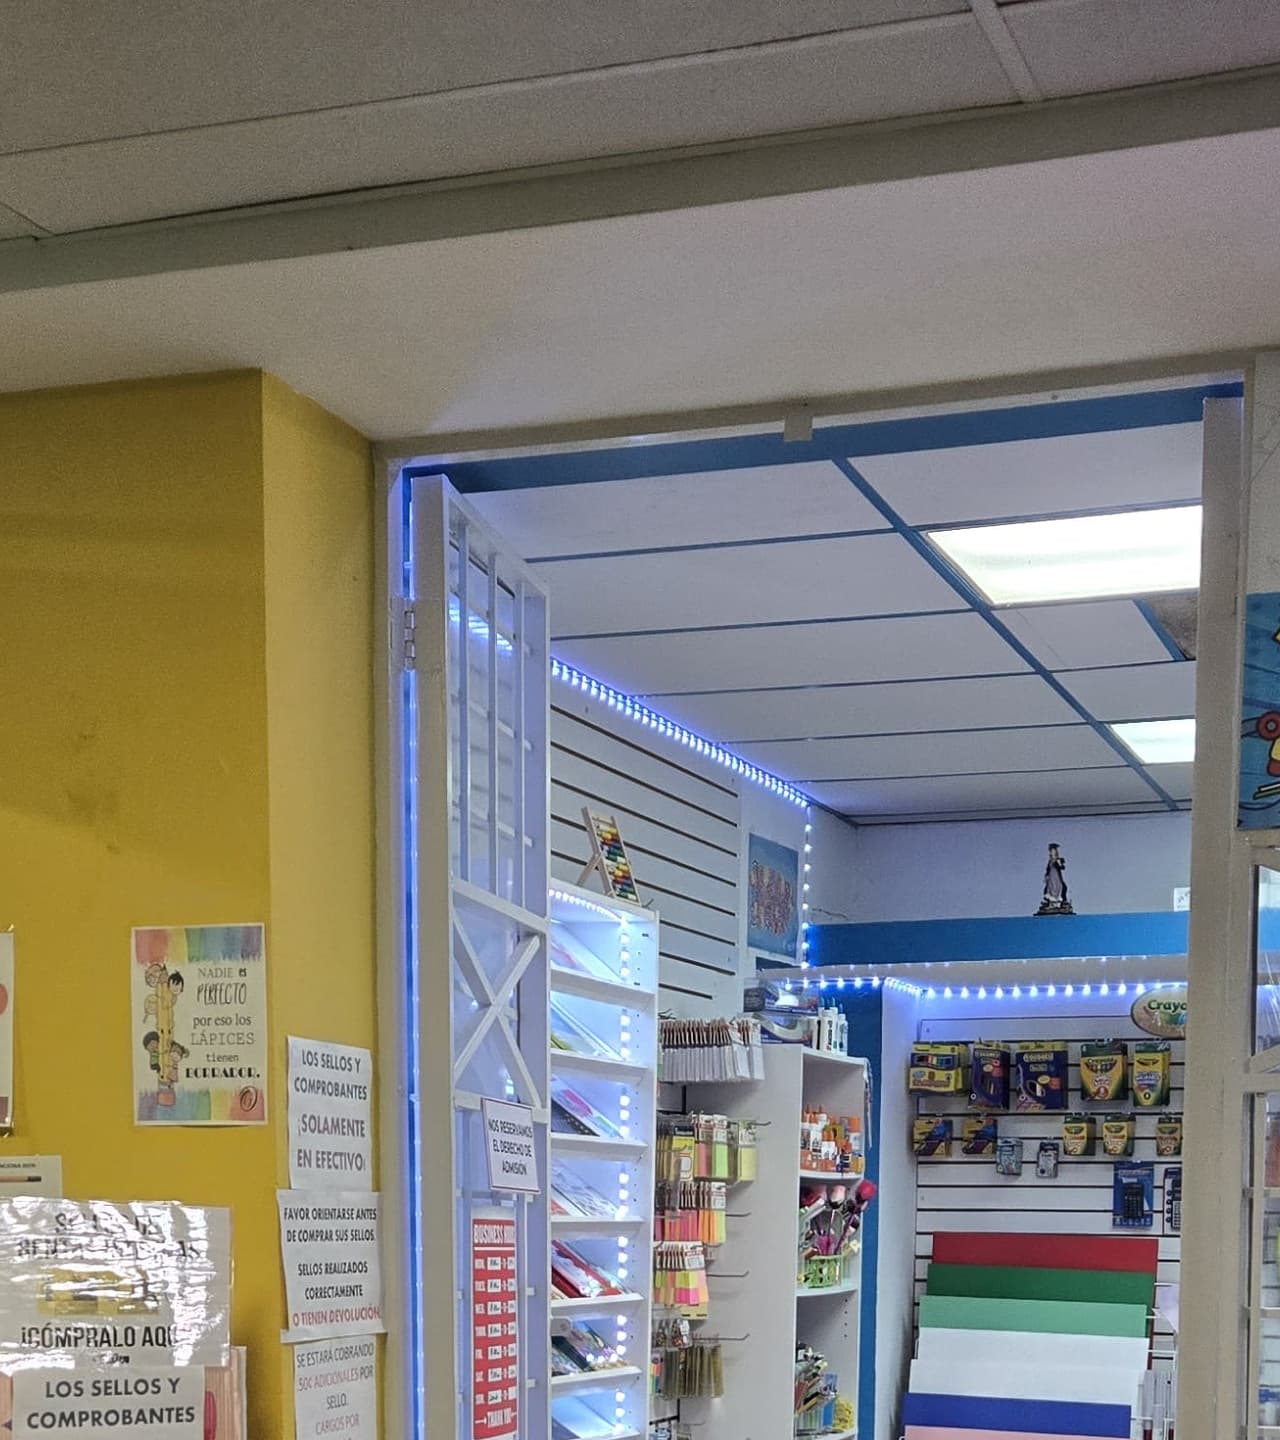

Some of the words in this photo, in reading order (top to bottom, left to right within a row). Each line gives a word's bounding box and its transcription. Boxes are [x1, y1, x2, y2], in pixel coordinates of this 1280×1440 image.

[1148, 1000, 1187, 1012] Crayo
[295, 1077, 367, 1100] COMPROBANTES
[284, 1208, 310, 1220] FAVOR
[312, 1208, 354, 1220] ORIENTARSE
[356, 1208, 376, 1220] ANTES
[298, 1264, 322, 1276] SELLOS
[325, 1261, 367, 1274] REALIZADOS
[305, 1285, 363, 1300] CORRECTAMENTE
[46, 1381, 84, 1398] LOS
[93, 1379, 161, 1396] SELLOS
[168, 1378, 180, 1394] Y
[27, 1407, 195, 1429] COMPROBANTES
